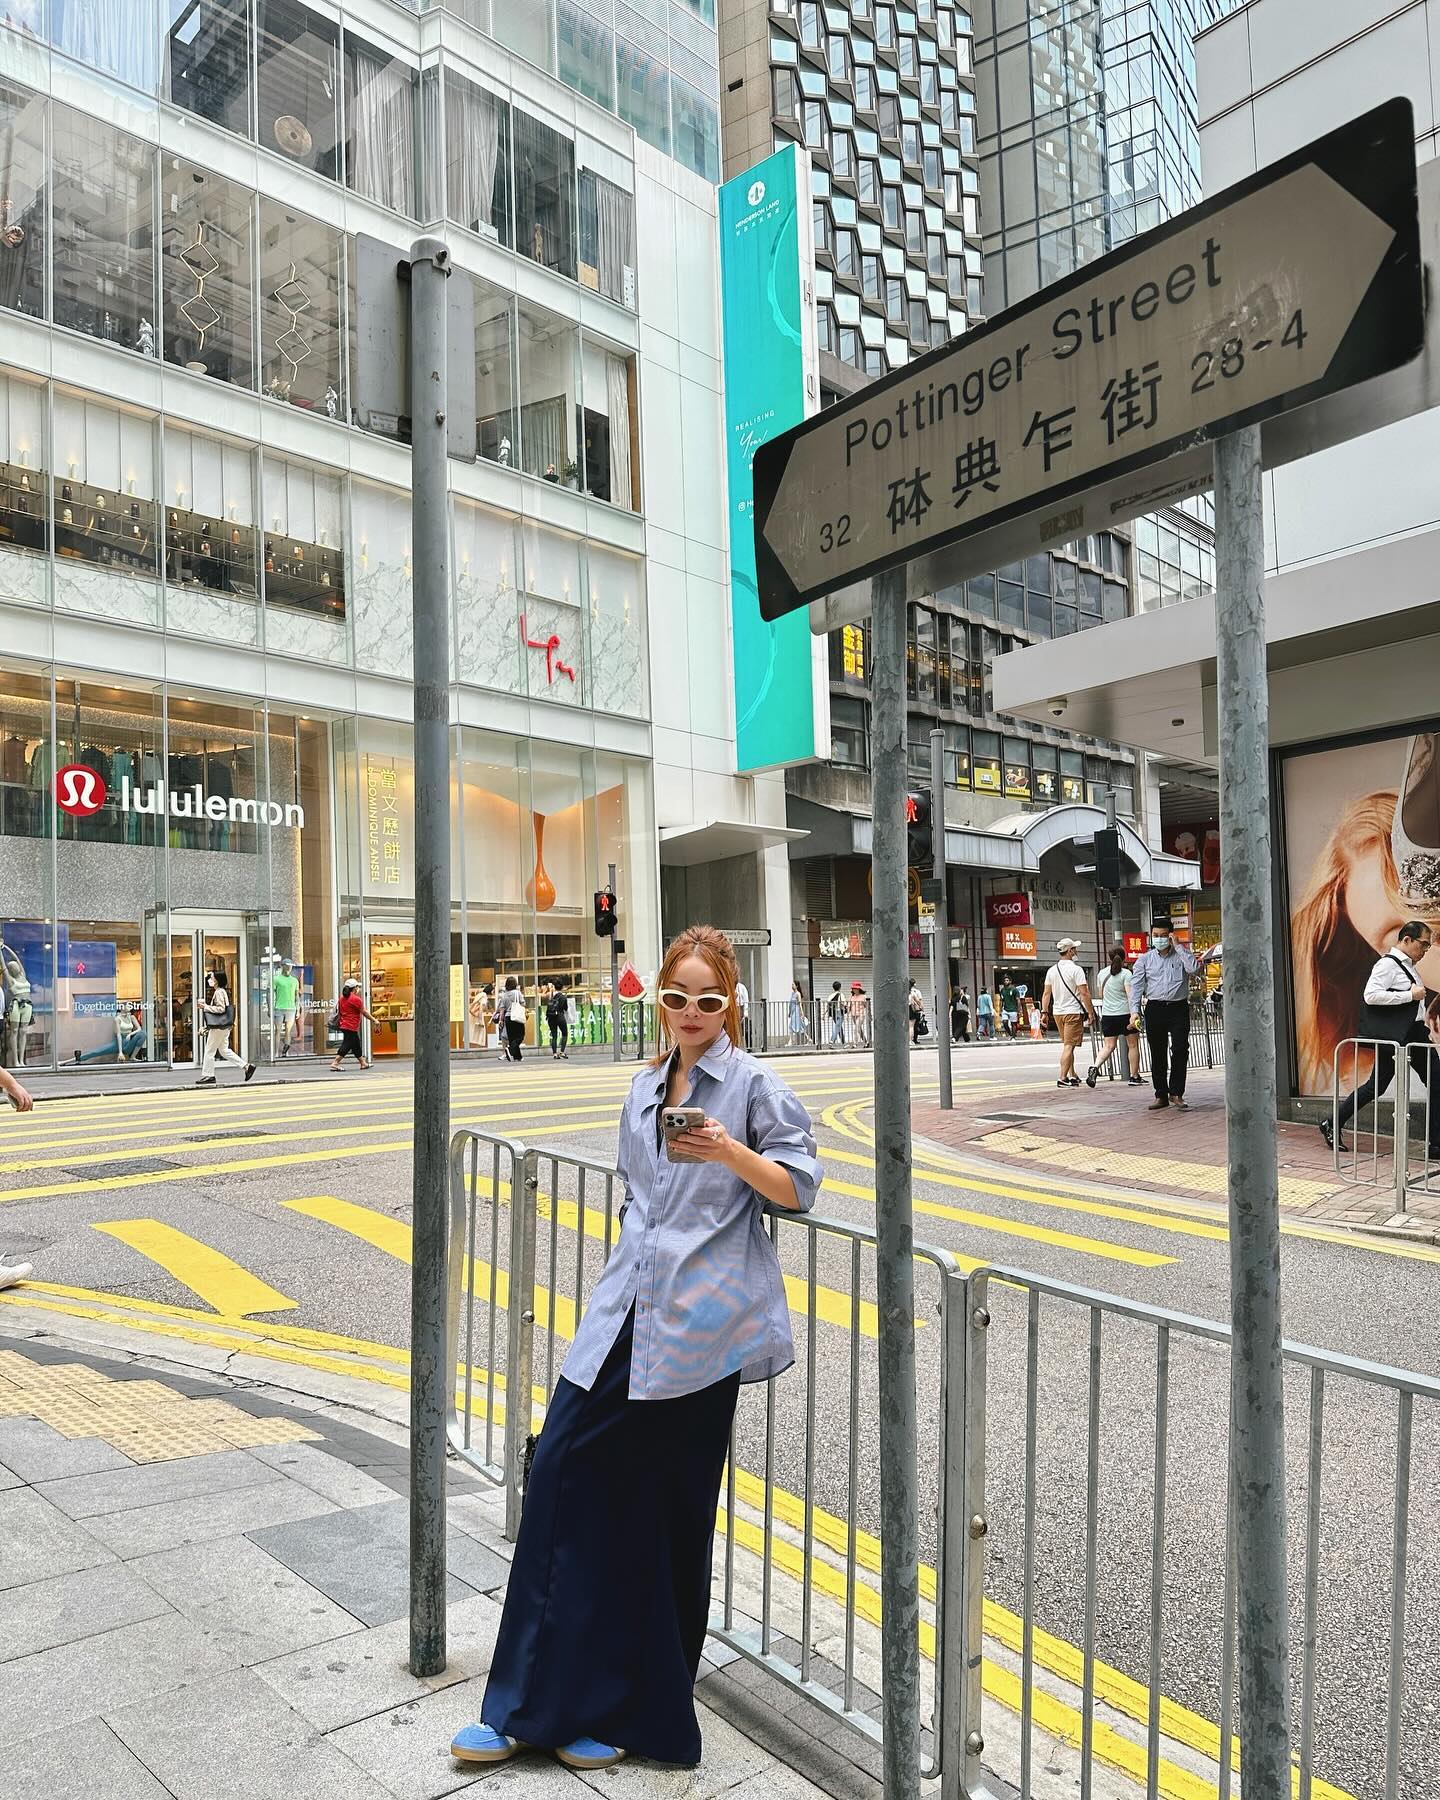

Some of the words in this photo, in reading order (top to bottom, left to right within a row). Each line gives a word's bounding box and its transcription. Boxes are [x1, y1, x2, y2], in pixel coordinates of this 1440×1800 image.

[735, 207, 765, 229] HENDERSON
[844, 341, 1030, 467] Pottinger
[1051, 237, 1223, 361] Street
[735, 409, 775, 432] REALISING
[818, 515, 852, 554] 32
[886, 360, 1163, 536] 砵典乍街
[1190, 307, 1309, 395] 28-4
[121, 775, 305, 829] lululemon
[368, 780, 379, 846] DOMINIQUE
[370, 849, 380, 883] ANSEL
[992, 902, 1022, 916] sasa
[1005, 941, 1033, 952] mannings
[73, 1001, 116, 1013] Together
[116, 1002, 125, 1010] in
